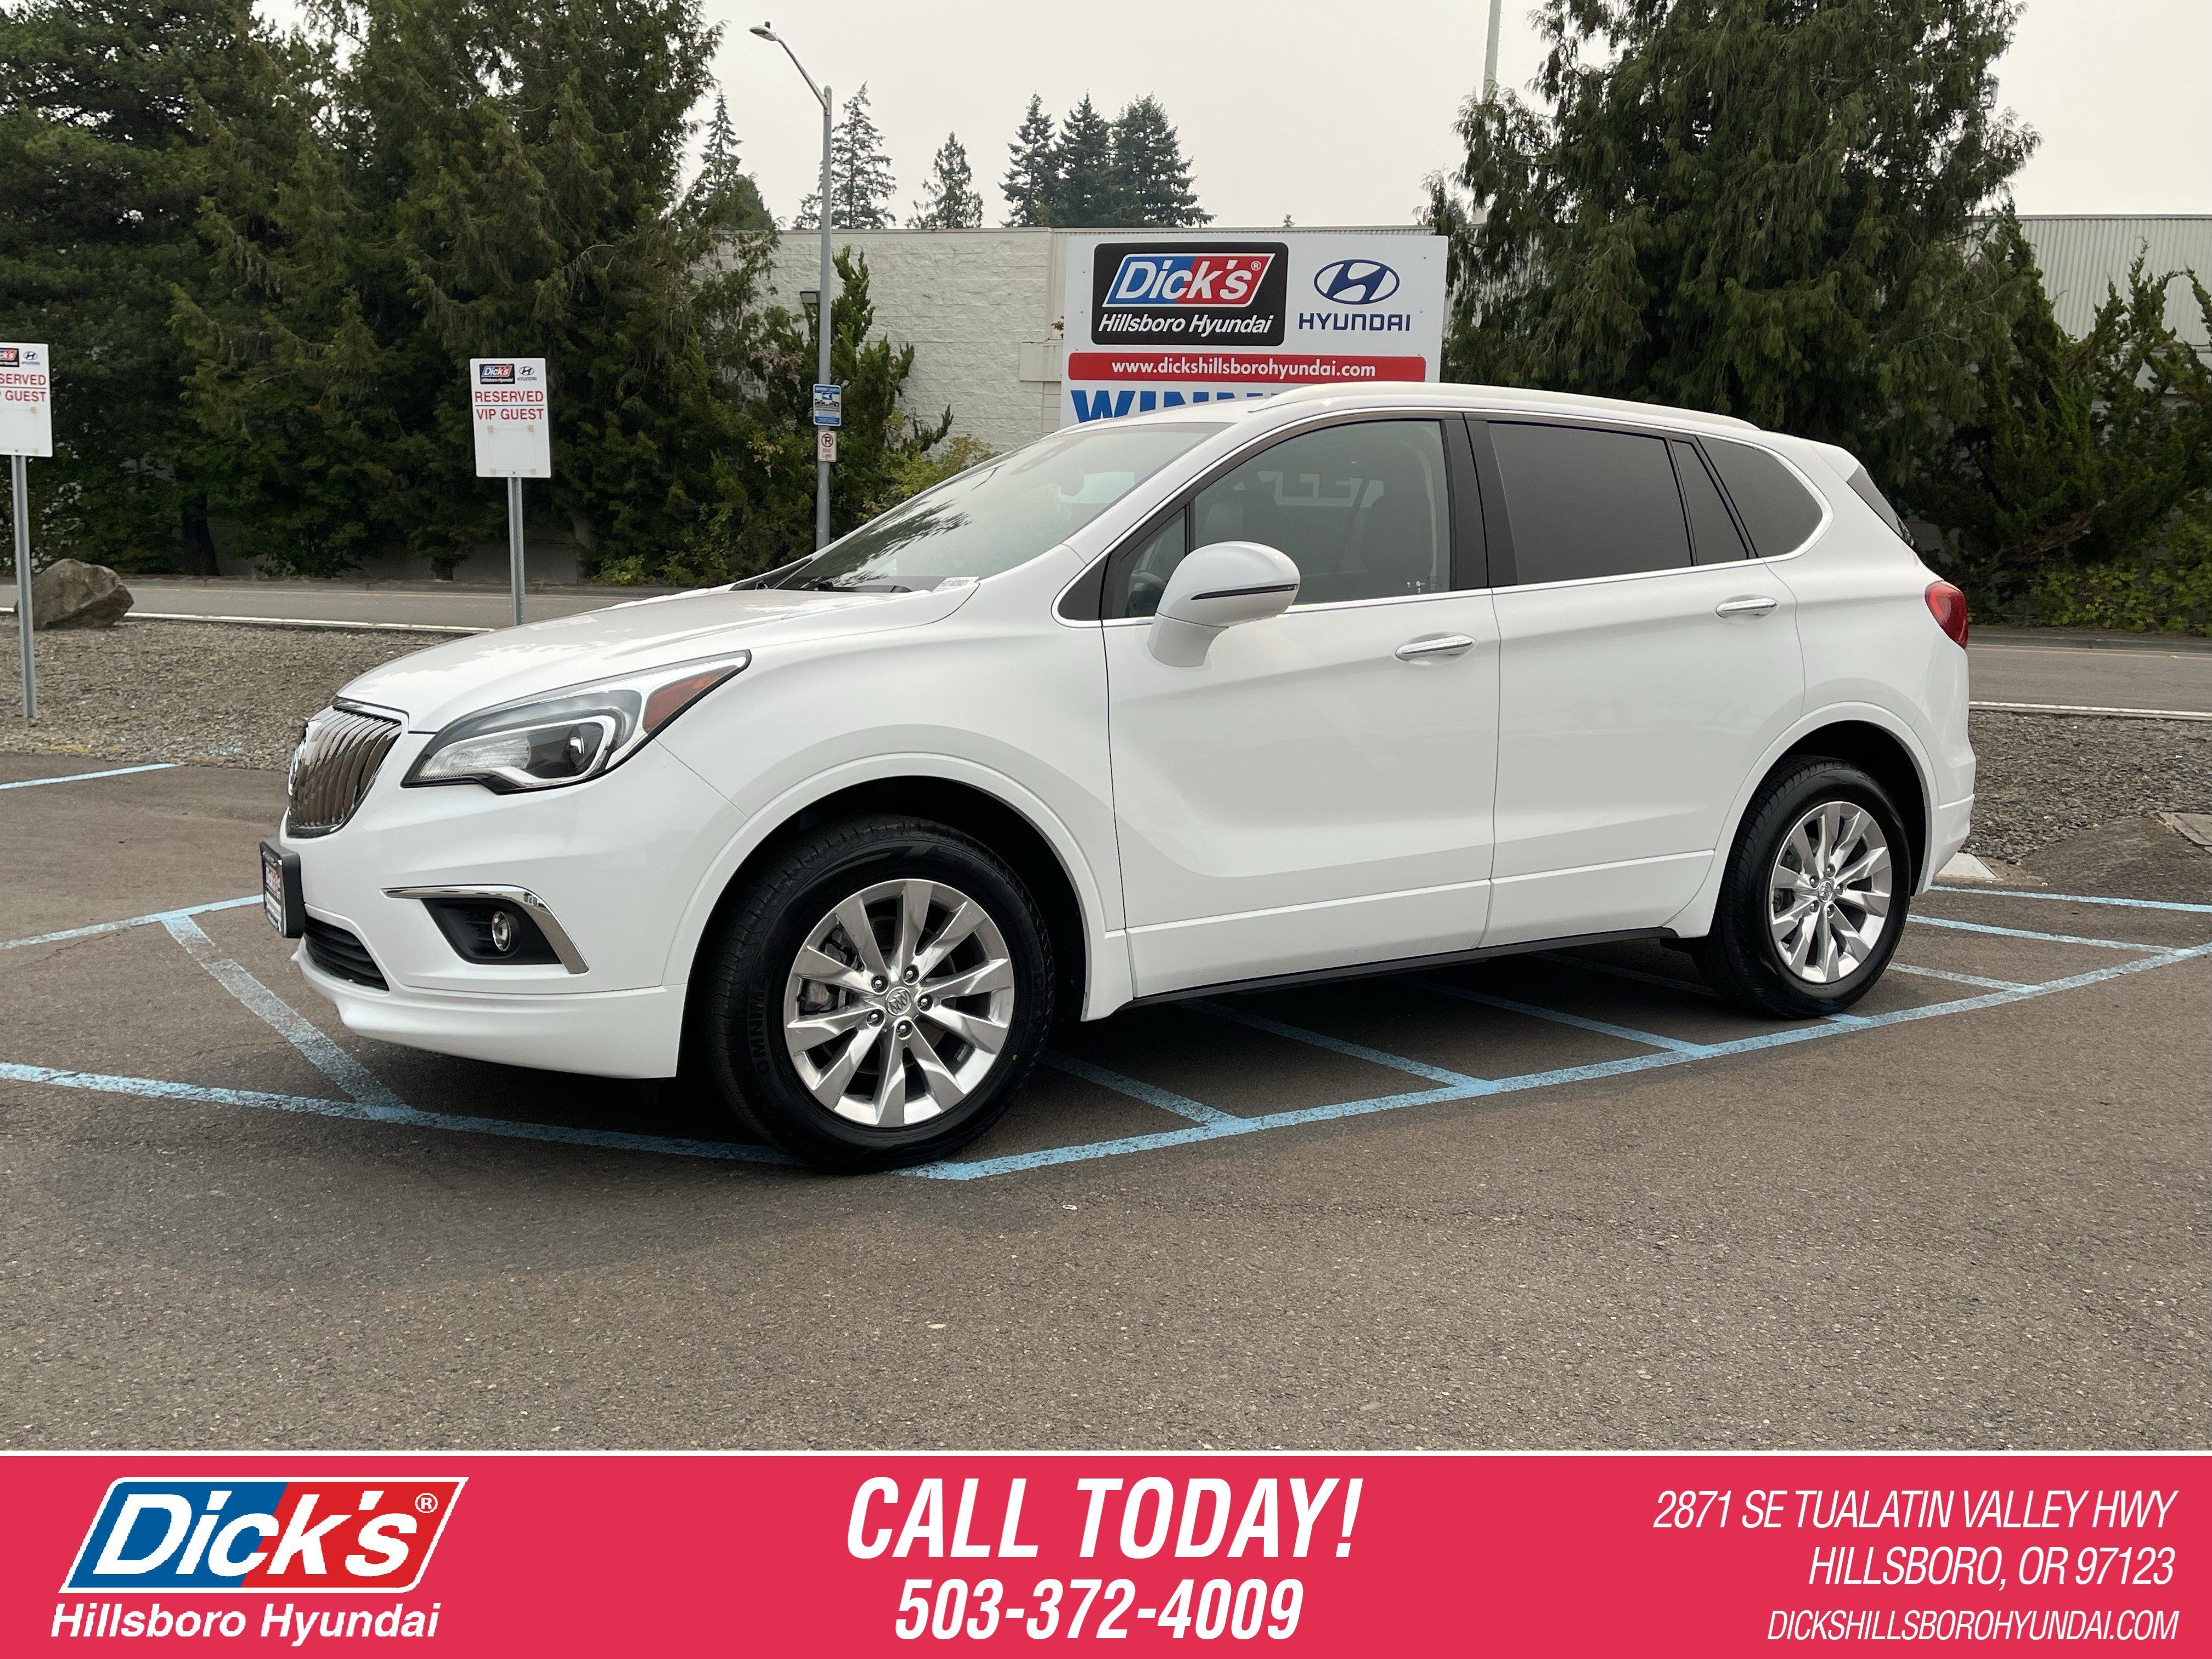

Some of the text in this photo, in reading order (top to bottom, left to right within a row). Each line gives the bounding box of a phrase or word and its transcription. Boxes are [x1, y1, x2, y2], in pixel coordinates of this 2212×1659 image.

[1098, 314, 1274, 337] Hillsboro Hyundai
[1299, 312, 1411, 331] HYUNDAI
[1111, 356, 1376, 380] www.dickshillsborohyundai.com
[5, 390, 46, 402] GUEST
[475, 391, 544, 402] RESERVED
[476, 409, 544, 420] VIP GUEST
